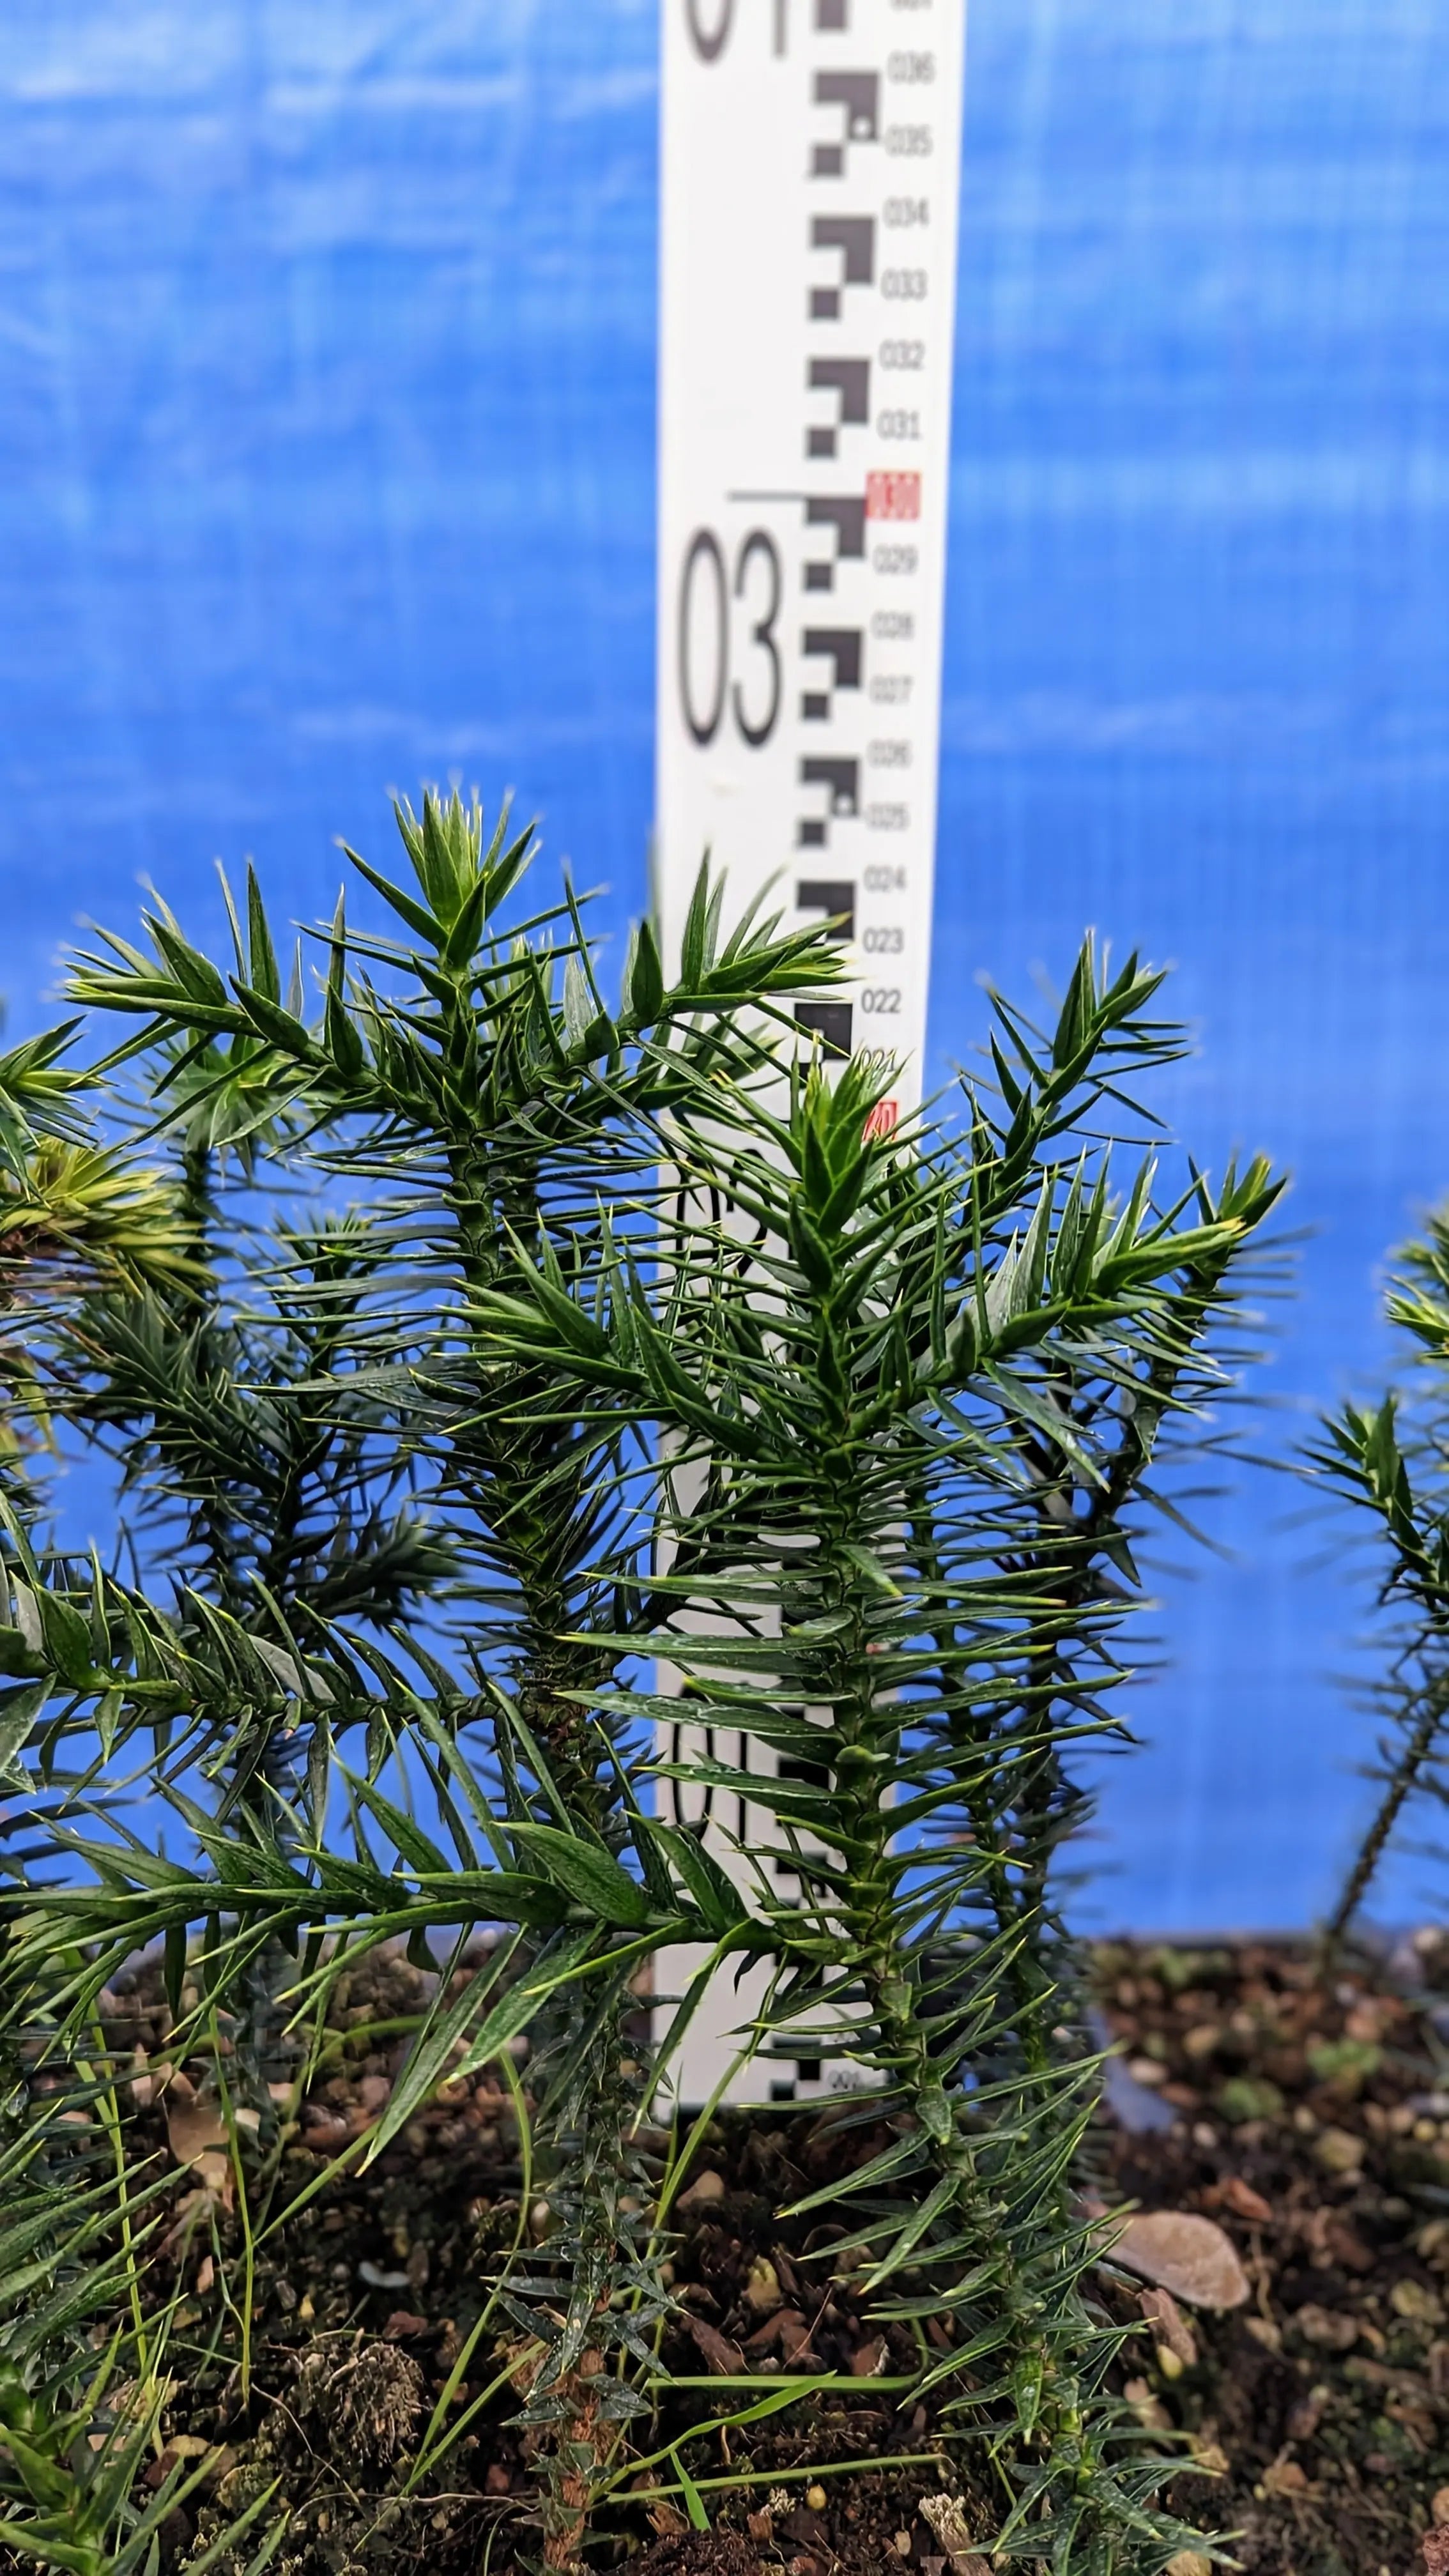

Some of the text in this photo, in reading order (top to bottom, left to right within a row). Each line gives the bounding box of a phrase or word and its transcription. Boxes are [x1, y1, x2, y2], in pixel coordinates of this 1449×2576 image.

[878, 339, 925, 371] 032
[877, 408, 921, 440] 031
[678, 526, 782, 750] 03
[864, 864, 907, 893] 024
[862, 927, 904, 954] 023
[861, 988, 901, 1014] 022
